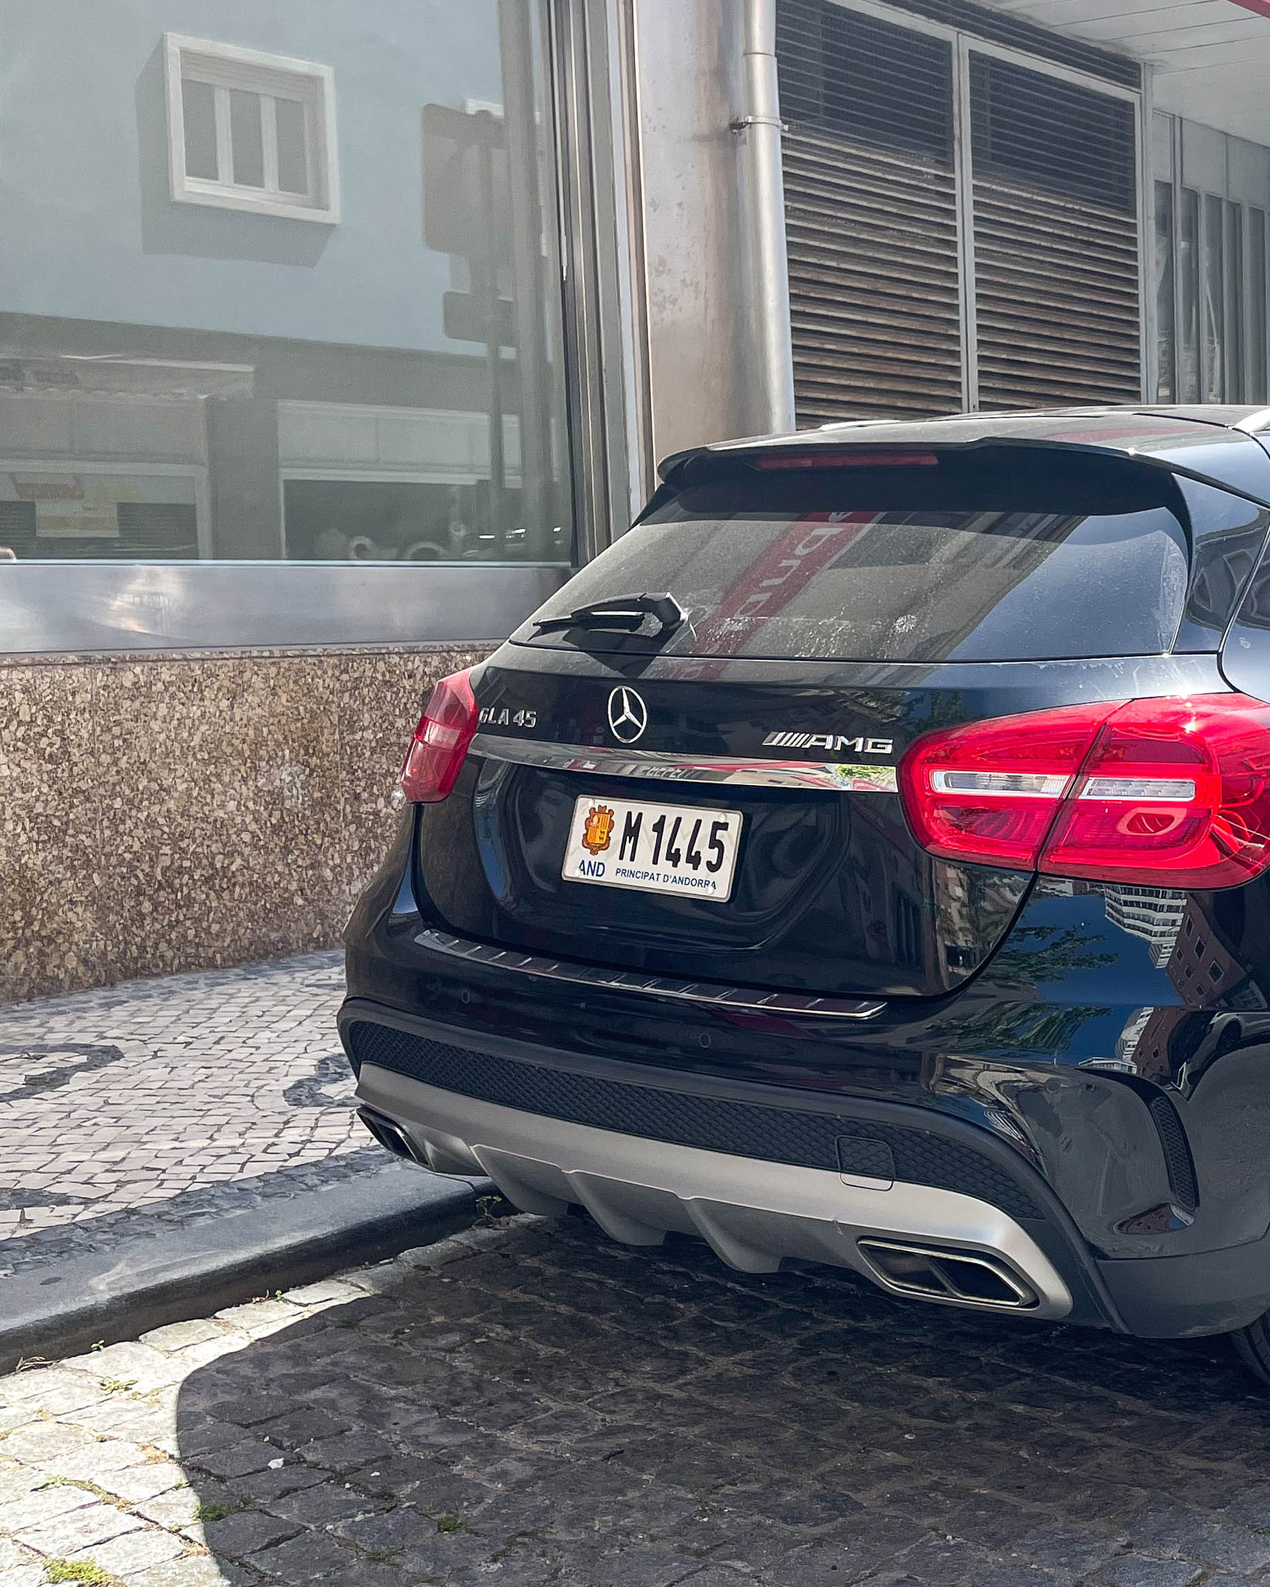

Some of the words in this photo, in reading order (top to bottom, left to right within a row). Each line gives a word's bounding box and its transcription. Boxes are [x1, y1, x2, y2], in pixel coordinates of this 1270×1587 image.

[478, 706, 509, 726] GLA
[512, 709, 537, 728] 45
[801, 733, 893, 754] AMG
[618, 811, 643, 862] M
[651, 815, 729, 873] 1445
[578, 859, 606, 877] AND
[615, 867, 661, 882] PRINCIPAT
[662, 873, 717, 890] D'ANDORRA
